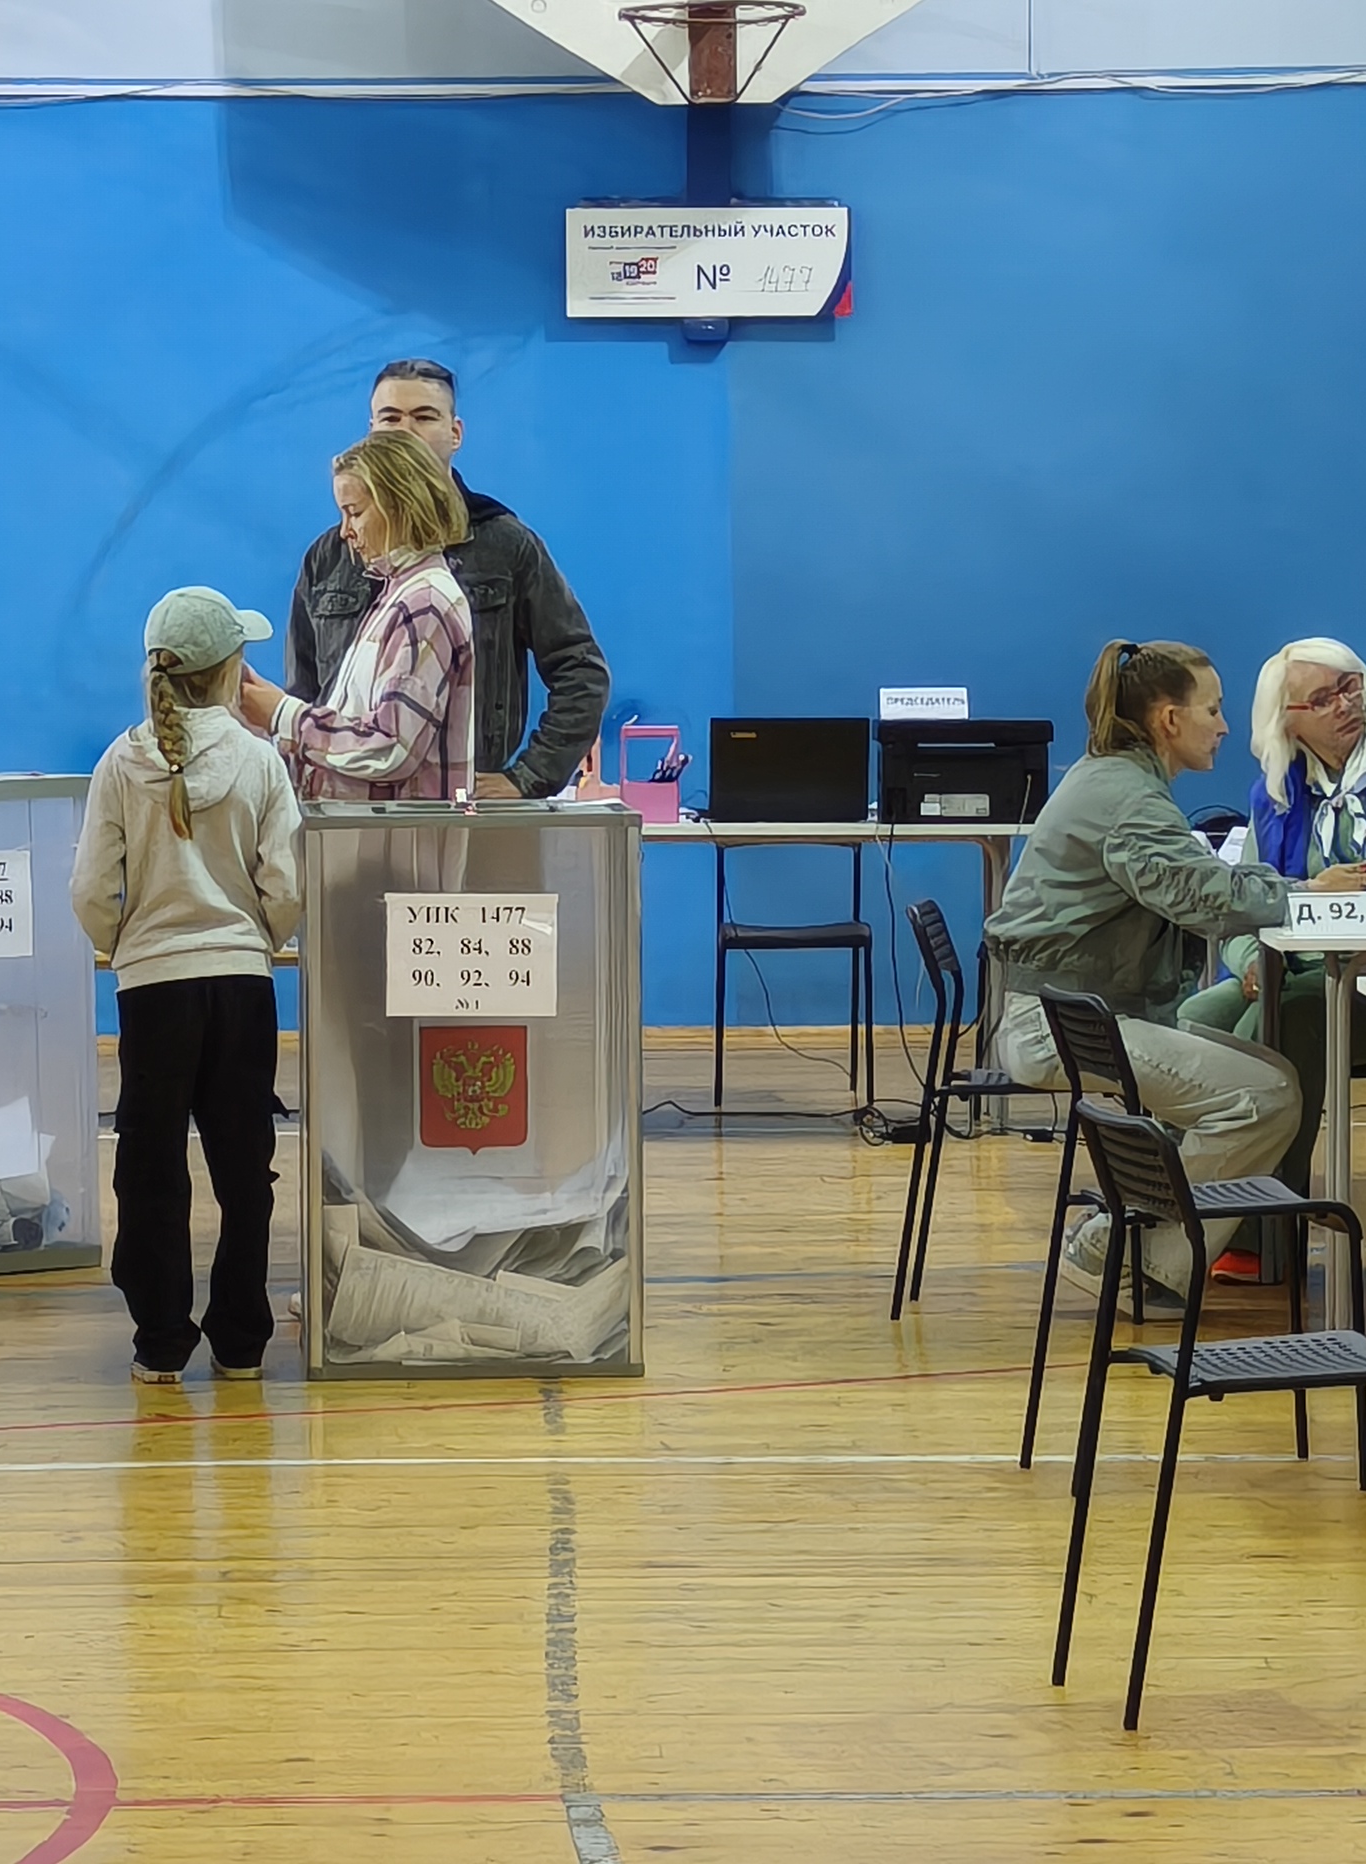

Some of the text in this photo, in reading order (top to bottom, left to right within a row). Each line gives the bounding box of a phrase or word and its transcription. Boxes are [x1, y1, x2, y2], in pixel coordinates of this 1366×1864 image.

[583, 220, 837, 239] ИЗБИРАТЕЛЬНЫЙ УЧАСТОК
[696, 264, 731, 290] №
[407, 906, 526, 924] УИК 1477
[1296, 903, 1321, 925] Д.
[1329, 902, 1365, 923] 92,
[509, 938, 532, 955] 88
[509, 969, 531, 986] 94
